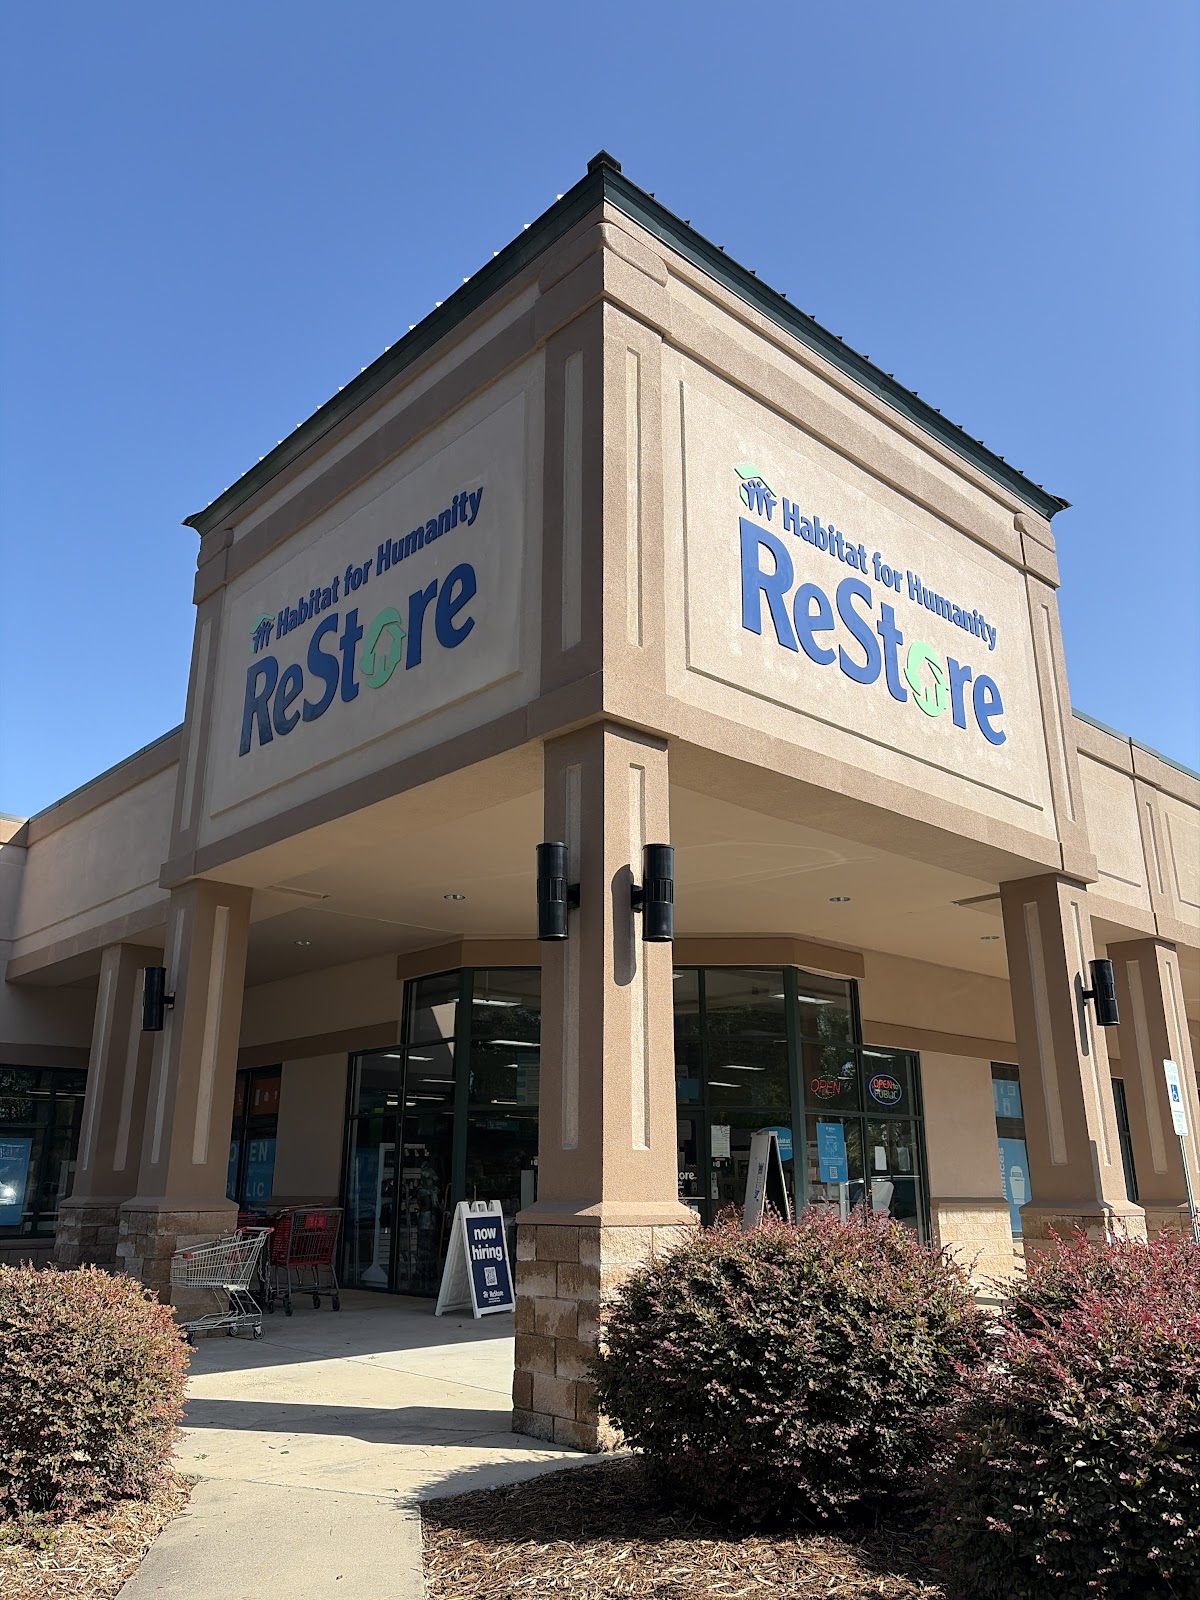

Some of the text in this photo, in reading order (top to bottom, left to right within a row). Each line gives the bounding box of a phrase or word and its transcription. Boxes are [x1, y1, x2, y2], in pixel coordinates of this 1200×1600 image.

[276, 486, 483, 640] Habitat for Humanity
[782, 496, 997, 651] Habitat for Humanity
[738, 516, 1007, 746] ReStore
[238, 562, 478, 758] ReStore
[810, 1079, 841, 1095] OPEN
[872, 1078, 893, 1090] OPEN
[873, 1089, 899, 1100] PUBLIC
[473, 1227, 497, 1240] now
[471, 1243, 503, 1262] hiring
